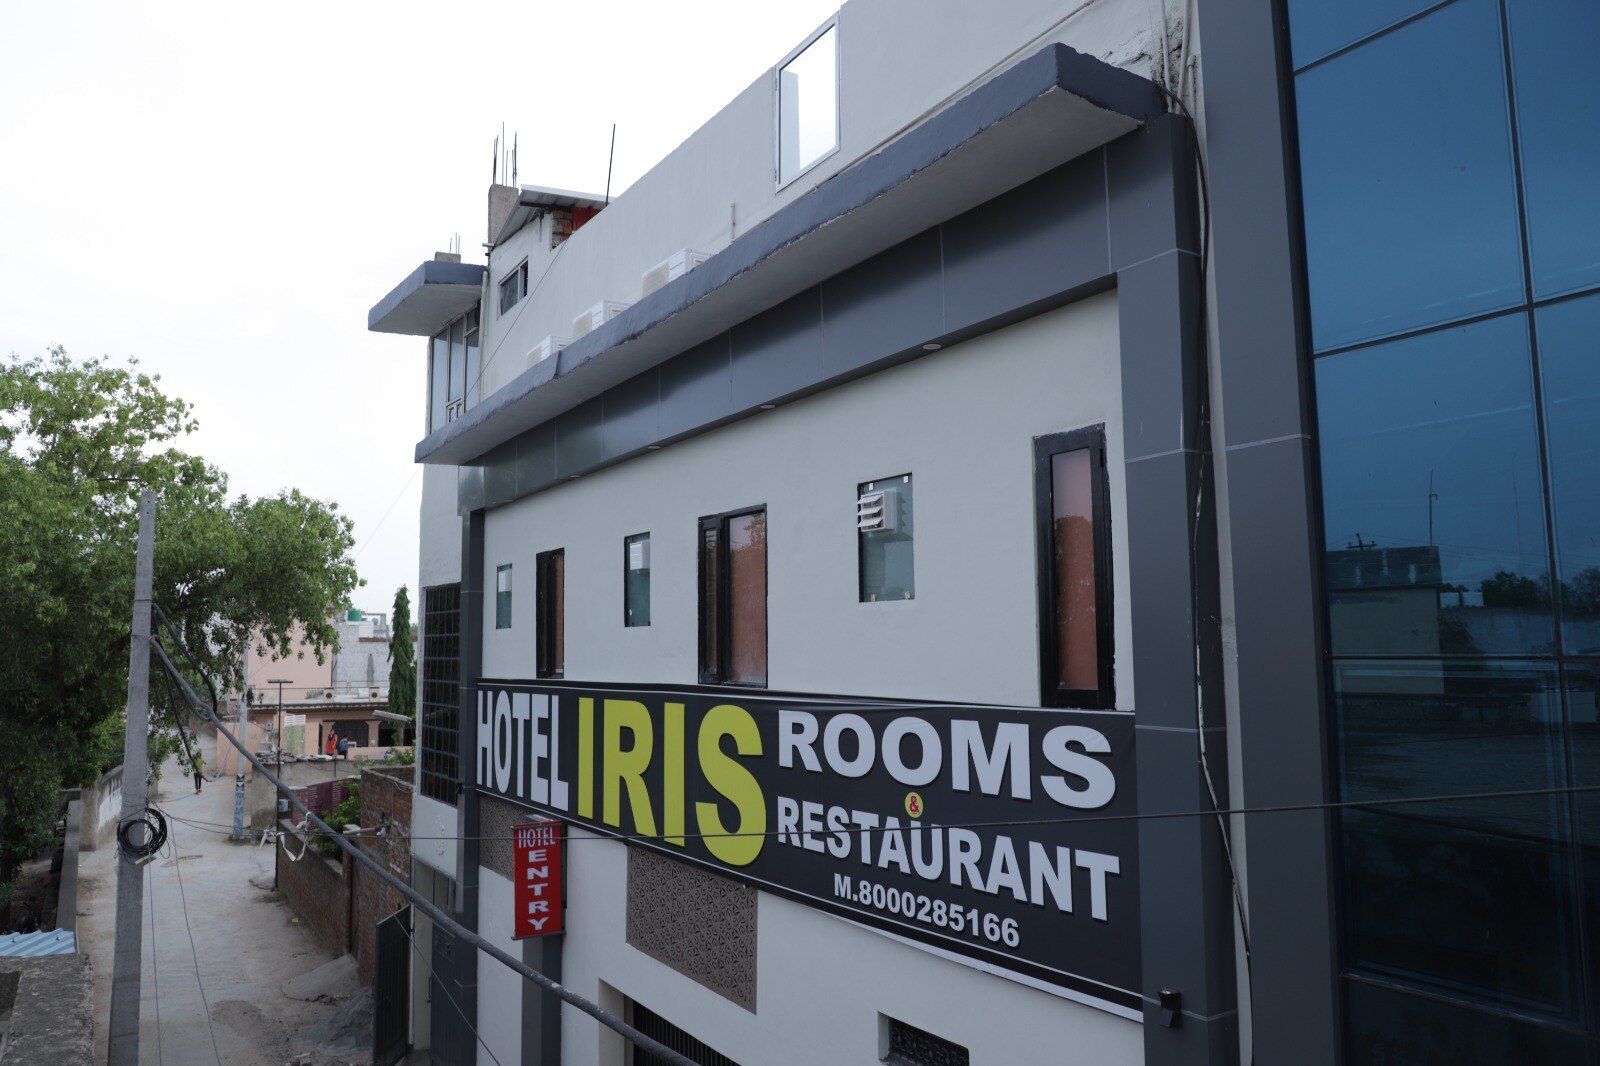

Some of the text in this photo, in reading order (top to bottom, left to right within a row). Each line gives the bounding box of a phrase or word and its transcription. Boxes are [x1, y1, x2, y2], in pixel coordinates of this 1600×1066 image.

[477, 690, 766, 866] HOTEL IRIS
[779, 710, 1116, 809] ROOMS
[518, 826, 556, 849] HOTEL
[777, 796, 1120, 921] RESTAURANT
[527, 849, 550, 931] ENTRY
[834, 873, 1020, 948] M.8000285166
